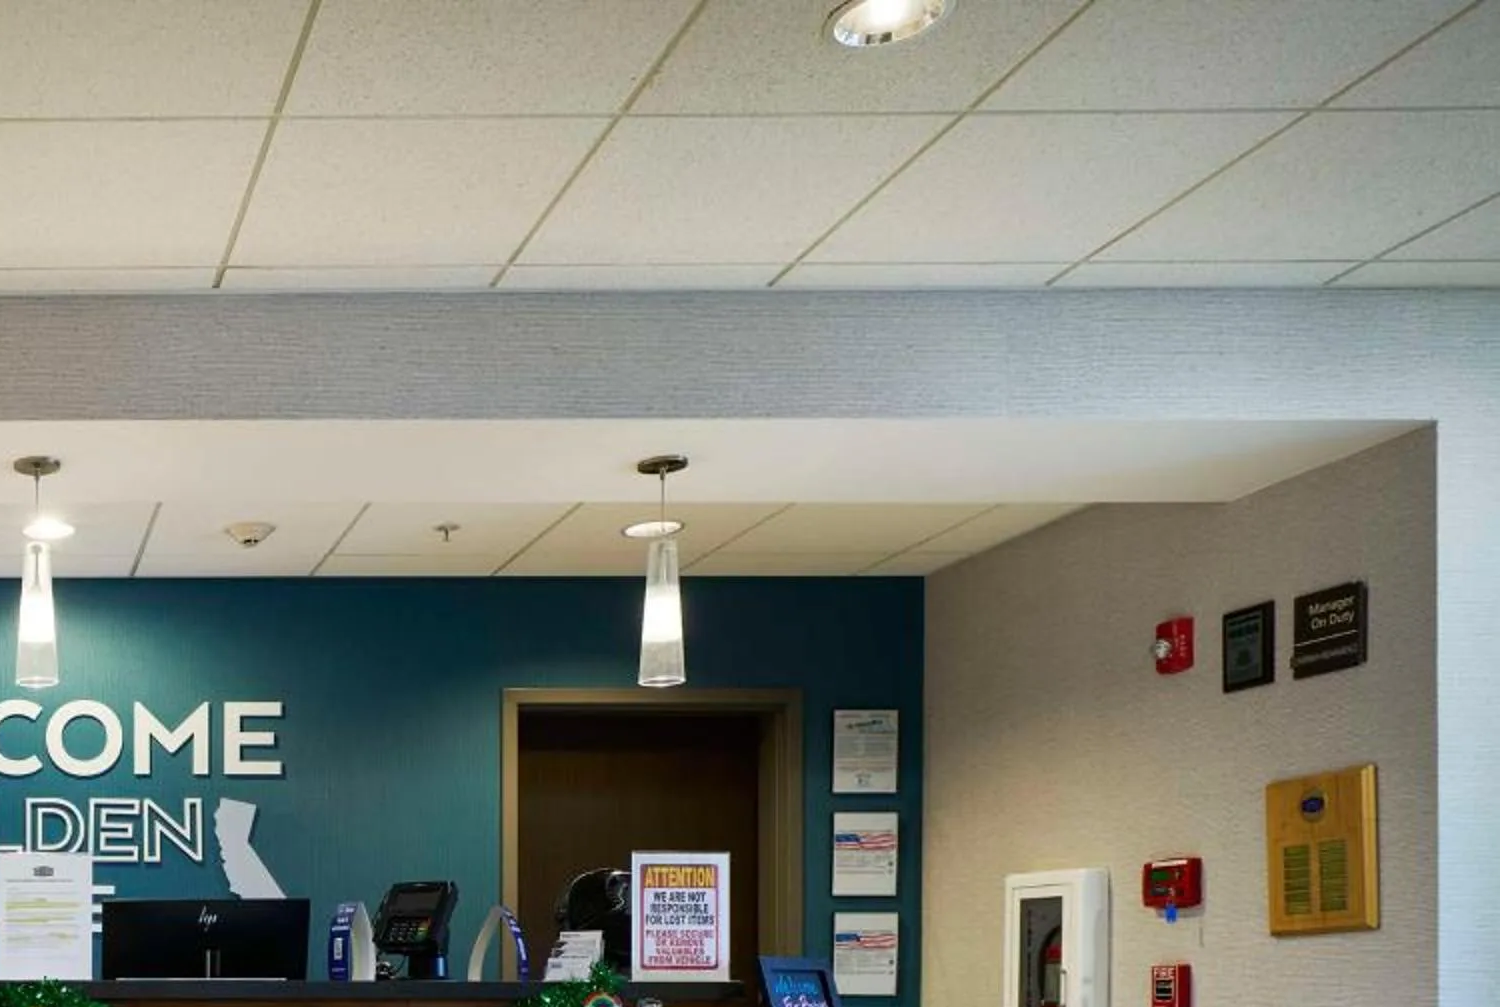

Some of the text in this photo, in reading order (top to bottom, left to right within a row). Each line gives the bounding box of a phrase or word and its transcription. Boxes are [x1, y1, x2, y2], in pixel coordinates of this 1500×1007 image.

[1308, 596, 1355, 615] Manager
[1311, 609, 1356, 630] On Duty
[644, 867, 714, 887] ATTENTION
[653, 892, 706, 902] WE ARE NOT
[650, 903, 708, 914] RESPONSIBLE
[646, 915, 714, 925] FOR LOST ITEMS
[646, 930, 714, 939] PLEASE SECURE
